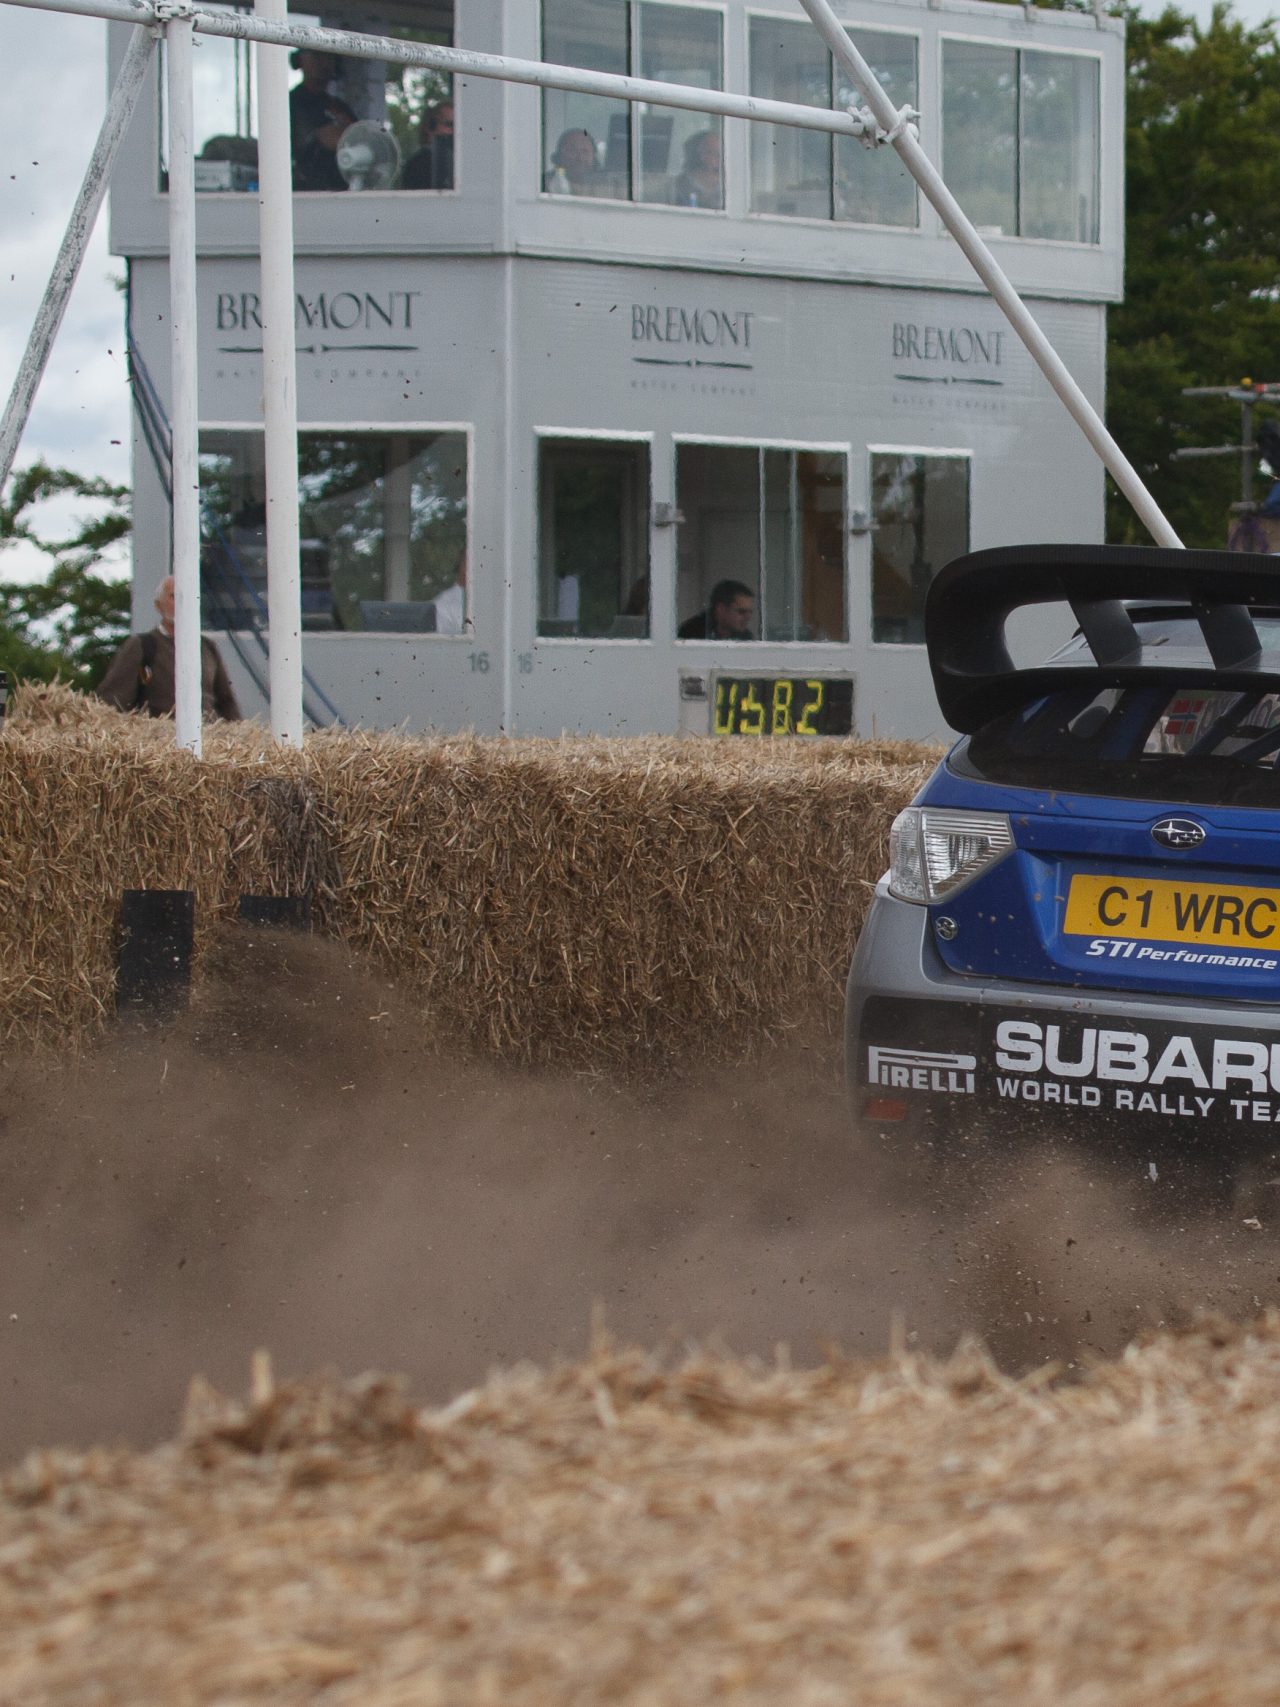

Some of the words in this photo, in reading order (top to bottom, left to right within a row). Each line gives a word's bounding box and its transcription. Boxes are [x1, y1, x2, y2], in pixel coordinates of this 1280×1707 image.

[217, 292, 420, 330] BRMONT
[632, 304, 754, 347] BREMONT
[893, 323, 1004, 365] BREMONT
[468, 652, 489, 674] 16
[517, 653, 534, 674] 16
[1098, 886, 1154, 928] C1
[1173, 892, 1278, 939] WRC
[1086, 939, 1138, 958] STI
[1137, 946, 1278, 970] Performance
[868, 1046, 977, 1094] PIRELLI
[996, 1077, 1101, 1108] WORLD
[1115, 1091, 1216, 1119] RALLY
